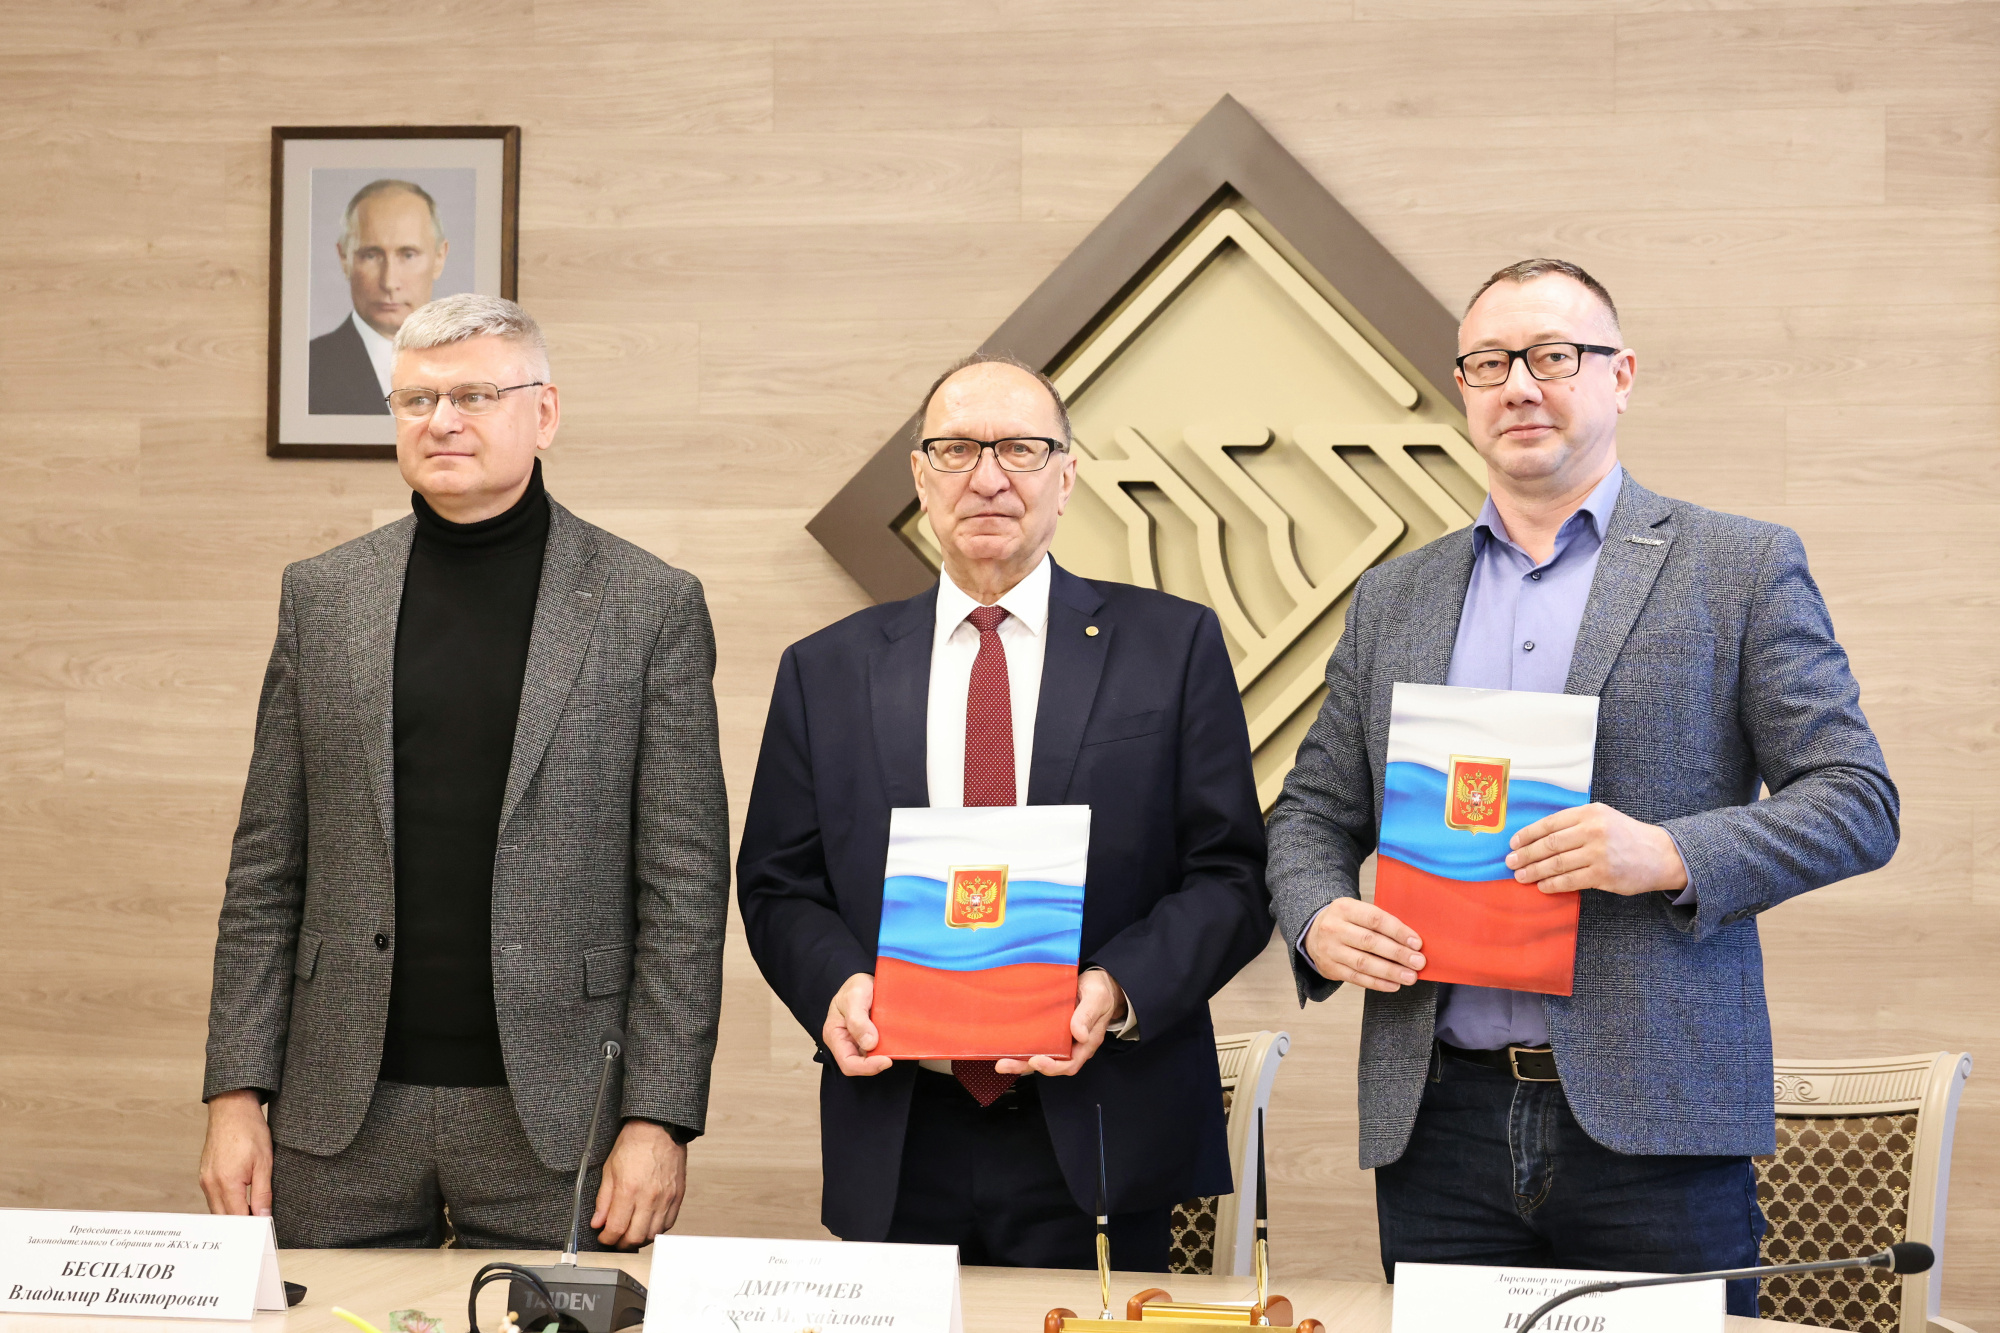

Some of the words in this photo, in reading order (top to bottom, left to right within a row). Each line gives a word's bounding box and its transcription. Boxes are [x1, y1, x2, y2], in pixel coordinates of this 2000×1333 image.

[68, 1225, 132, 1236] Председатель
[133, 1228, 182, 1237] комитета
[27, 1236, 108, 1247] Законодательного
[109, 1238, 153, 1249] Собрания
[154, 1241, 166, 1249] по
[167, 1240, 192, 1249] ЖКХ
[201, 1241, 222, 1250] ТЭК
[60, 1260, 176, 1281] БЕСПАЛОВ
[1494, 1273, 1548, 1286] Директор
[1550, 1278, 1563, 1286] по
[733, 1279, 864, 1300] ДМИТРИЕВ
[1508, 1286, 1534, 1297] ООО
[8, 1284, 101, 1308] Владимир
[104, 1287, 220, 1310] Викторович
